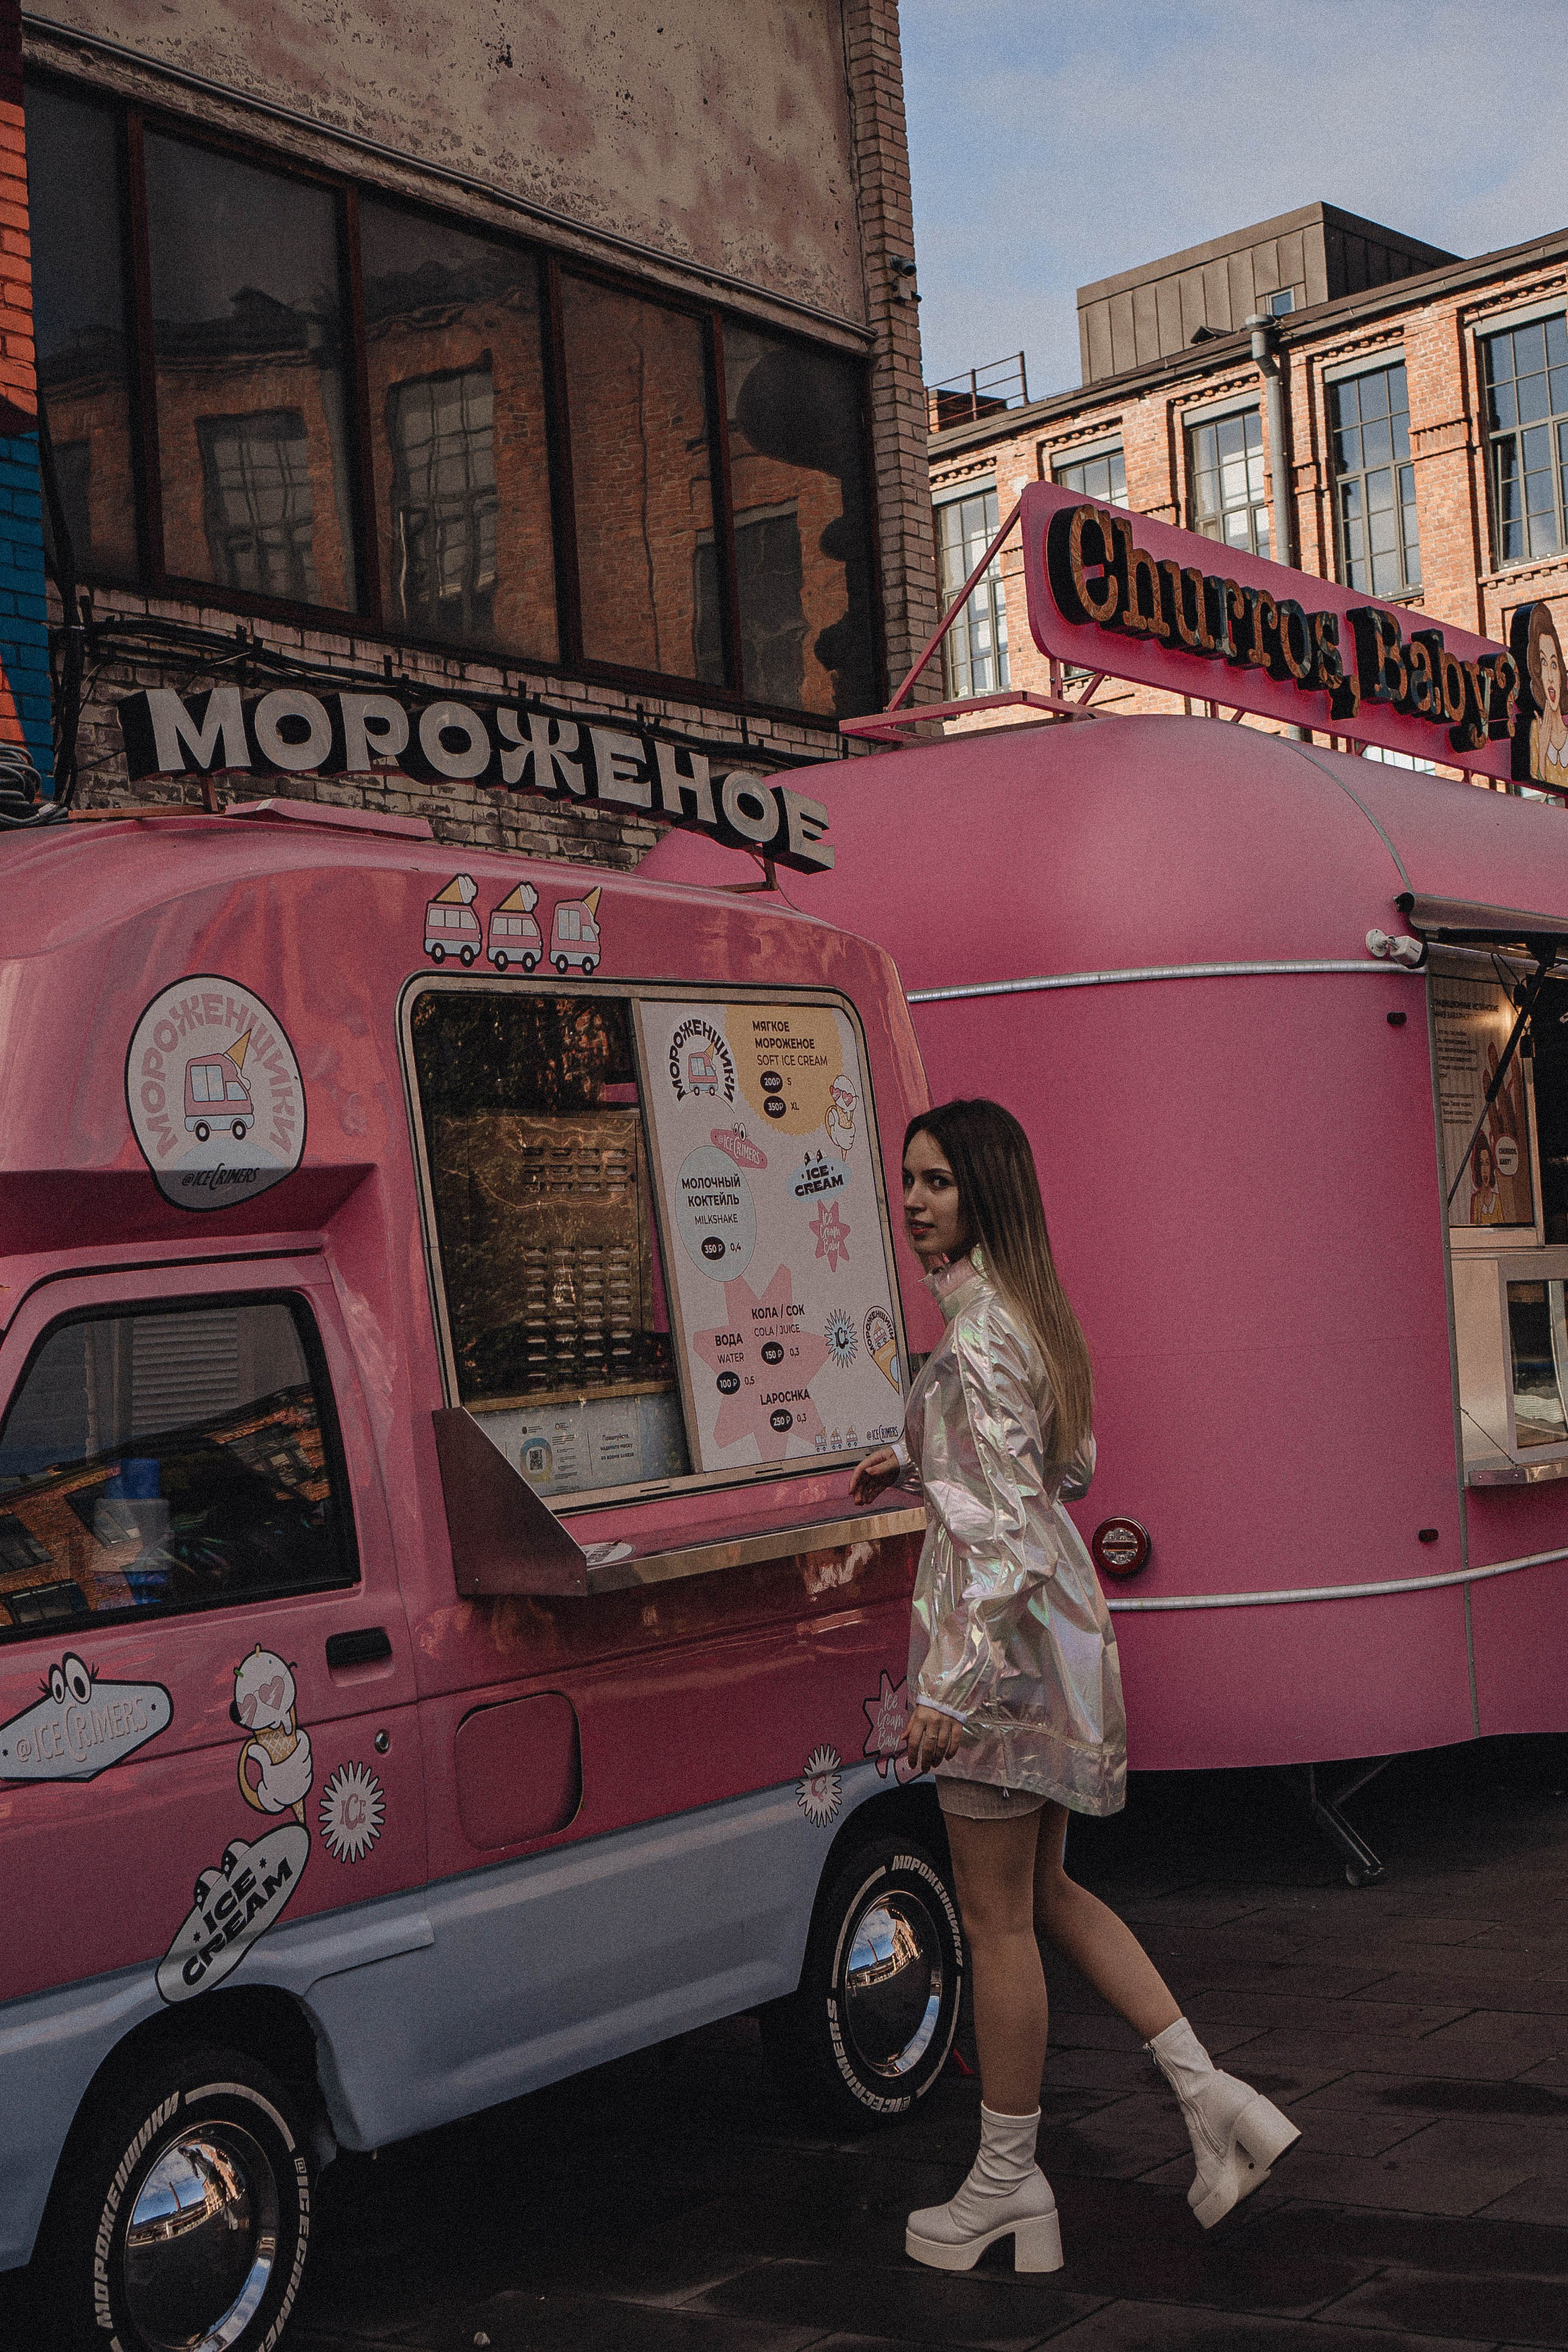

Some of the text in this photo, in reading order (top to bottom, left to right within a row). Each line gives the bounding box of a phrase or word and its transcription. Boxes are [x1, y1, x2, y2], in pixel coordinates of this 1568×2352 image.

[1049, 502, 1520, 754] Churros, Baby?
[145, 686, 837, 865] МОРОЖЕНОЕ
[752, 1020, 790, 1033] МЯГКОЕ
[754, 1038, 815, 1049] МОРОЖЕНОЕ
[669, 1019, 735, 1104] МОРОЖЕНЩИКИ
[757, 1055, 828, 1066] SOFT ICE CREAM
[140, 993, 295, 1158] МОРОЖЕНЩИКИ
[787, 1077, 792, 1086] S
[790, 1102, 800, 1110] XL
[806, 1165, 829, 1180] ICE
[681, 1173, 741, 1189] МОЛОЧНЫЙ
[794, 1174, 844, 1197] CREAM
[687, 1191, 740, 1207] КОКТЕЙЛЬ
[695, 1213, 738, 1225] MILKSHAKE
[822, 1210, 833, 1226] Ice
[820, 1224, 841, 1238] Cream
[704, 1245, 717, 1254] 350
[729, 1242, 742, 1253] 0,4
[822, 1237, 840, 1257] Baby
[751, 1306, 778, 1320] КОЛА
[786, 1304, 805, 1317] СОК
[754, 1326, 775, 1337] COLA
[780, 1324, 801, 1335] JUICE
[835, 1327, 850, 1350] ICE
[865, 1310, 894, 1356] МОРОЖЕНЩИКИ
[715, 1332, 744, 1347] ВОДА
[717, 1352, 744, 1364] WATER
[766, 1350, 776, 1360] 150
[790, 1348, 800, 1359] 0,3
[720, 1379, 731, 1389] 100
[744, 1376, 755, 1387] 0,5
[760, 1389, 810, 1406] LAPOCHKA
[773, 1416, 785, 1427] 250
[797, 1413, 807, 1424] 0,3
[883, 1689, 898, 1711] Ice
[876, 1708, 904, 1731] Cream
[876, 1727, 900, 1752] Baby
[340, 1793, 367, 1830] ICE
[202, 1866, 257, 1932] ICE
[891, 1855, 963, 1968] МОРОЖЕНЩИКИ
[183, 1857, 293, 1986] CREAM
[94, 2090, 180, 2329] МОРОЖЕНЩИКИ
[256, 2157, 310, 2352] @ICECRIME
